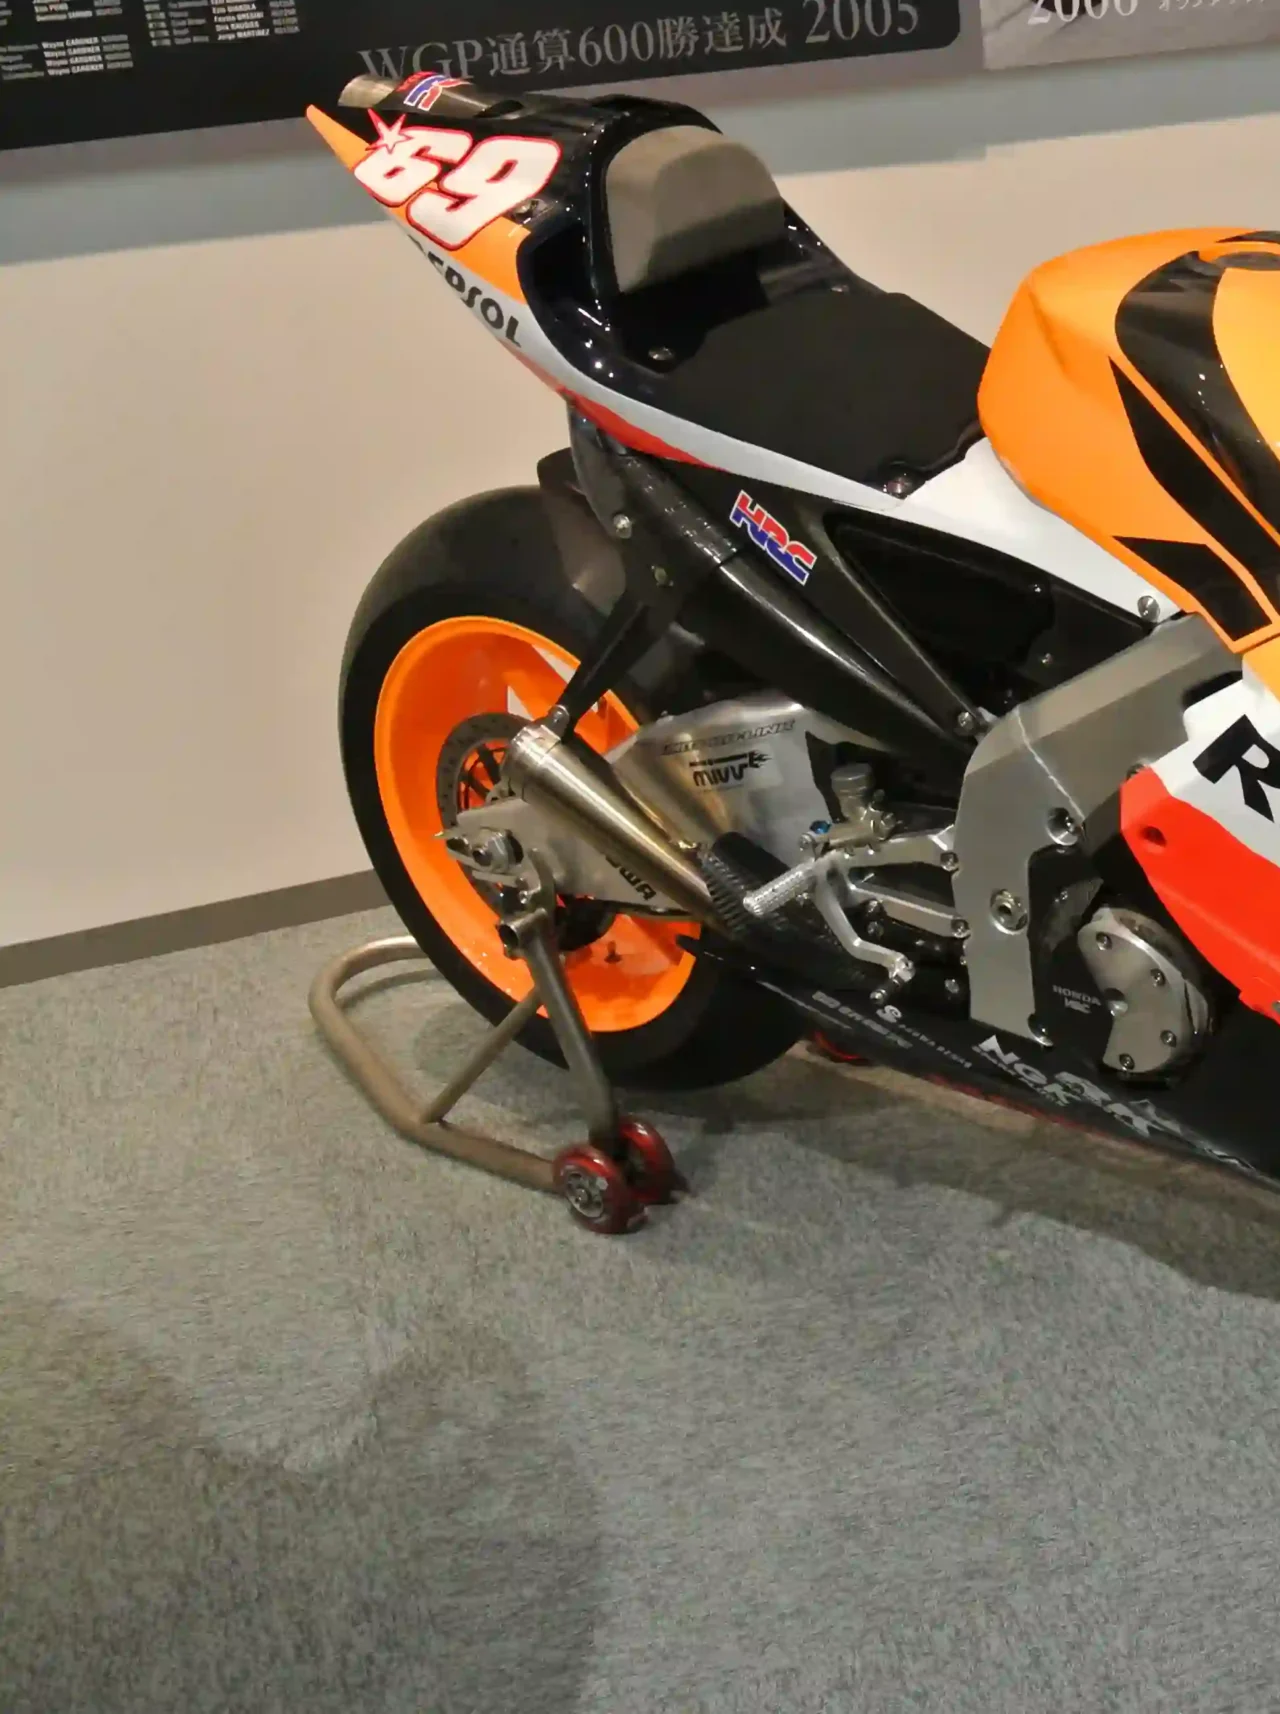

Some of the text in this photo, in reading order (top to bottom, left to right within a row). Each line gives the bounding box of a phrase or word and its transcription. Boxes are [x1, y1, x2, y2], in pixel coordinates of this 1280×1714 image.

[803, 0, 919, 43] 2005
[354, 120, 563, 252] 69
[408, 234, 522, 349] PSOL
